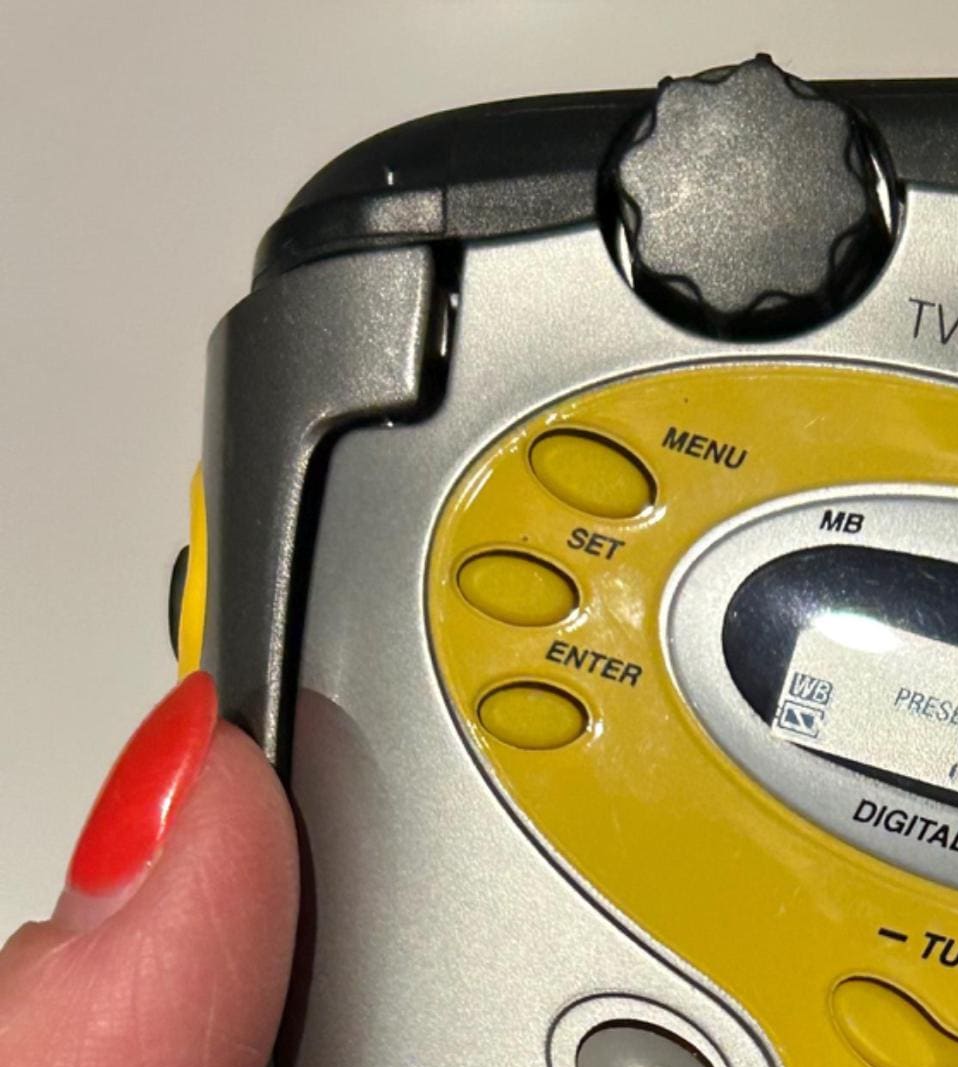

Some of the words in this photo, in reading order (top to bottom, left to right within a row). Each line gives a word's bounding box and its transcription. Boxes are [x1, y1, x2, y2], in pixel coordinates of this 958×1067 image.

[662, 427, 748, 469] MENU
[819, 510, 864, 534] MB
[567, 527, 625, 560] SET
[545, 640, 643, 687] ENTER
[789, 672, 833, 706] WB
